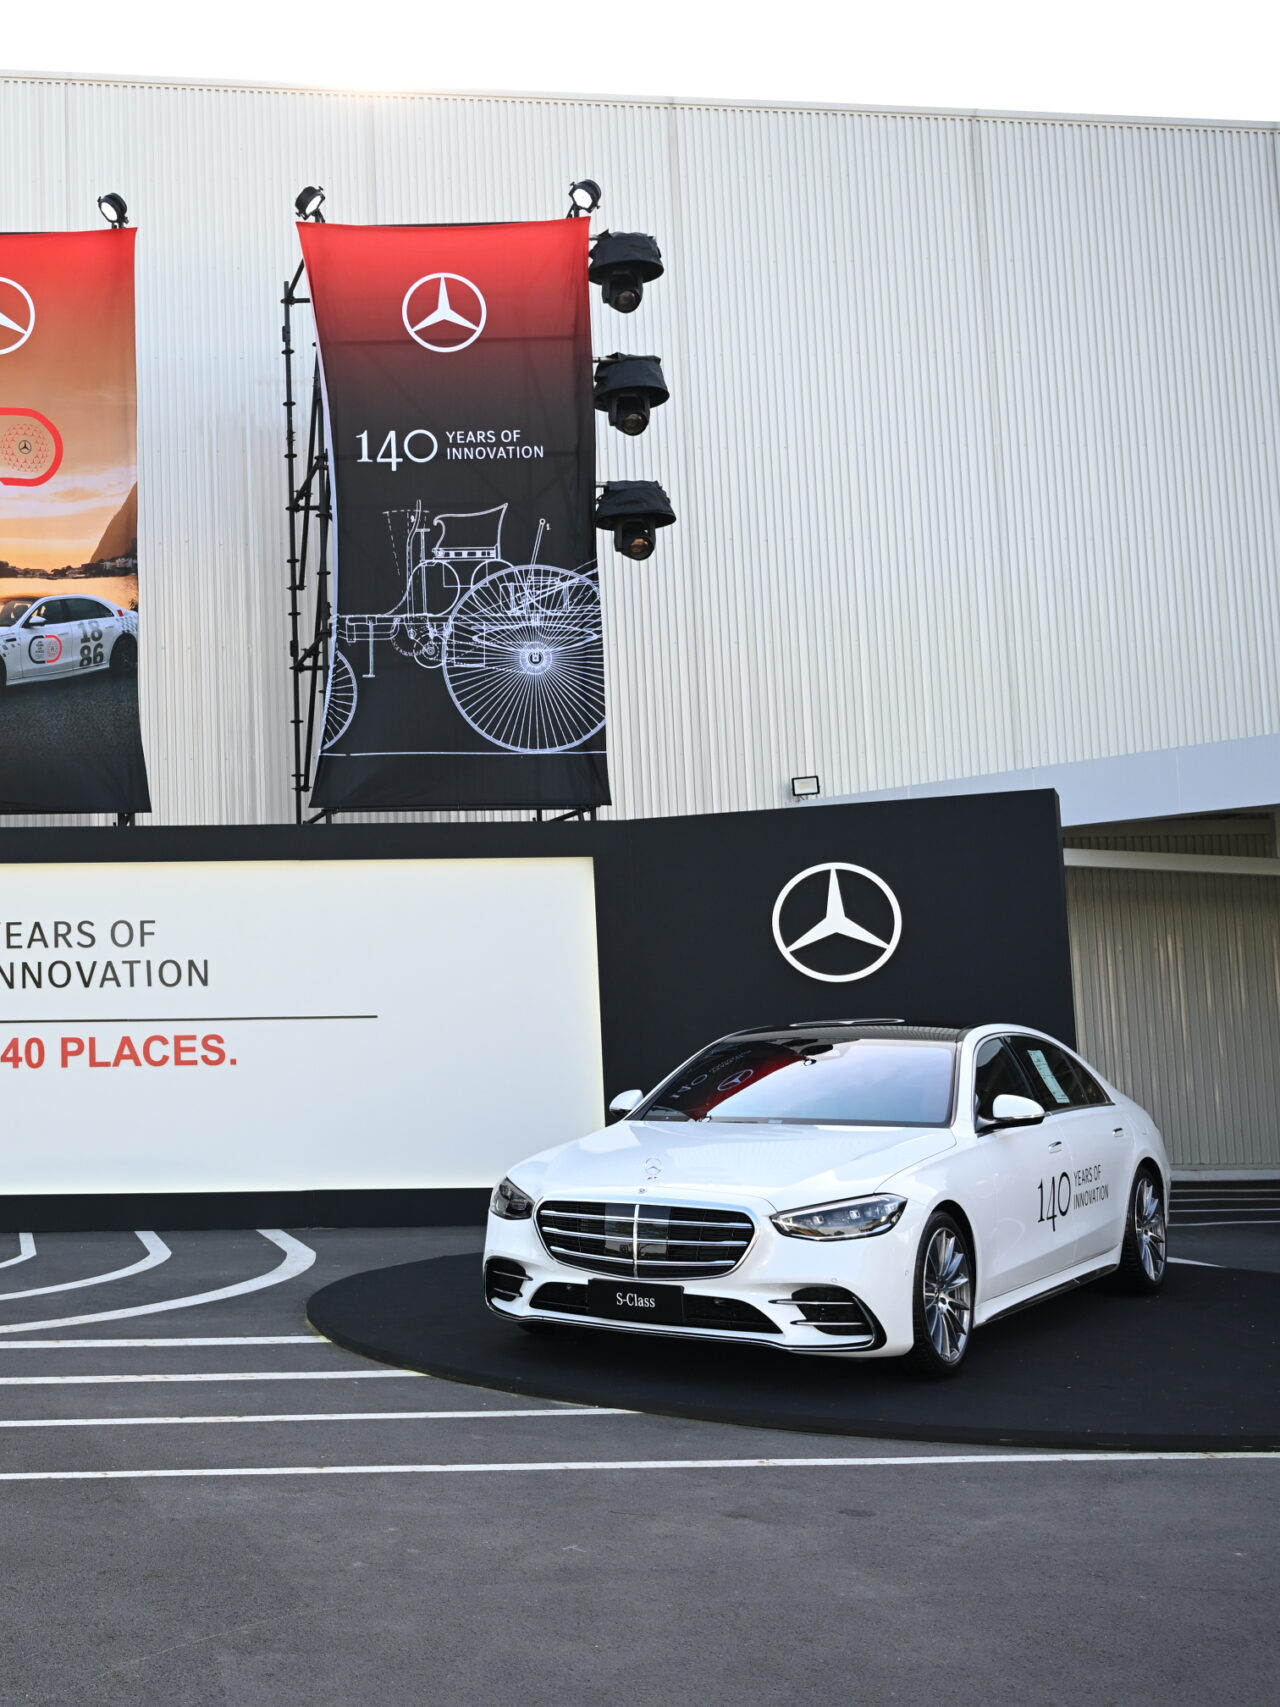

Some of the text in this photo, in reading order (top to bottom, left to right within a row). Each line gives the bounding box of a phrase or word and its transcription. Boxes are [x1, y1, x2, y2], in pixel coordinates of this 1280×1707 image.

[446, 429, 521, 444] YEARS OF
[355, 429, 438, 471] 140
[447, 445, 544, 460] INNOVATION
[77, 620, 103, 643] 18
[80, 643, 104, 667] 86
[110, 919, 156, 948] OF
[60, 1034, 237, 1068] PLACES.
[1074, 1164, 1101, 1187] YEARS OF
[1037, 1172, 1071, 1232] 140
[1073, 1184, 1109, 1210] INNOVATION
[616, 1292, 656, 1308] S-Class
